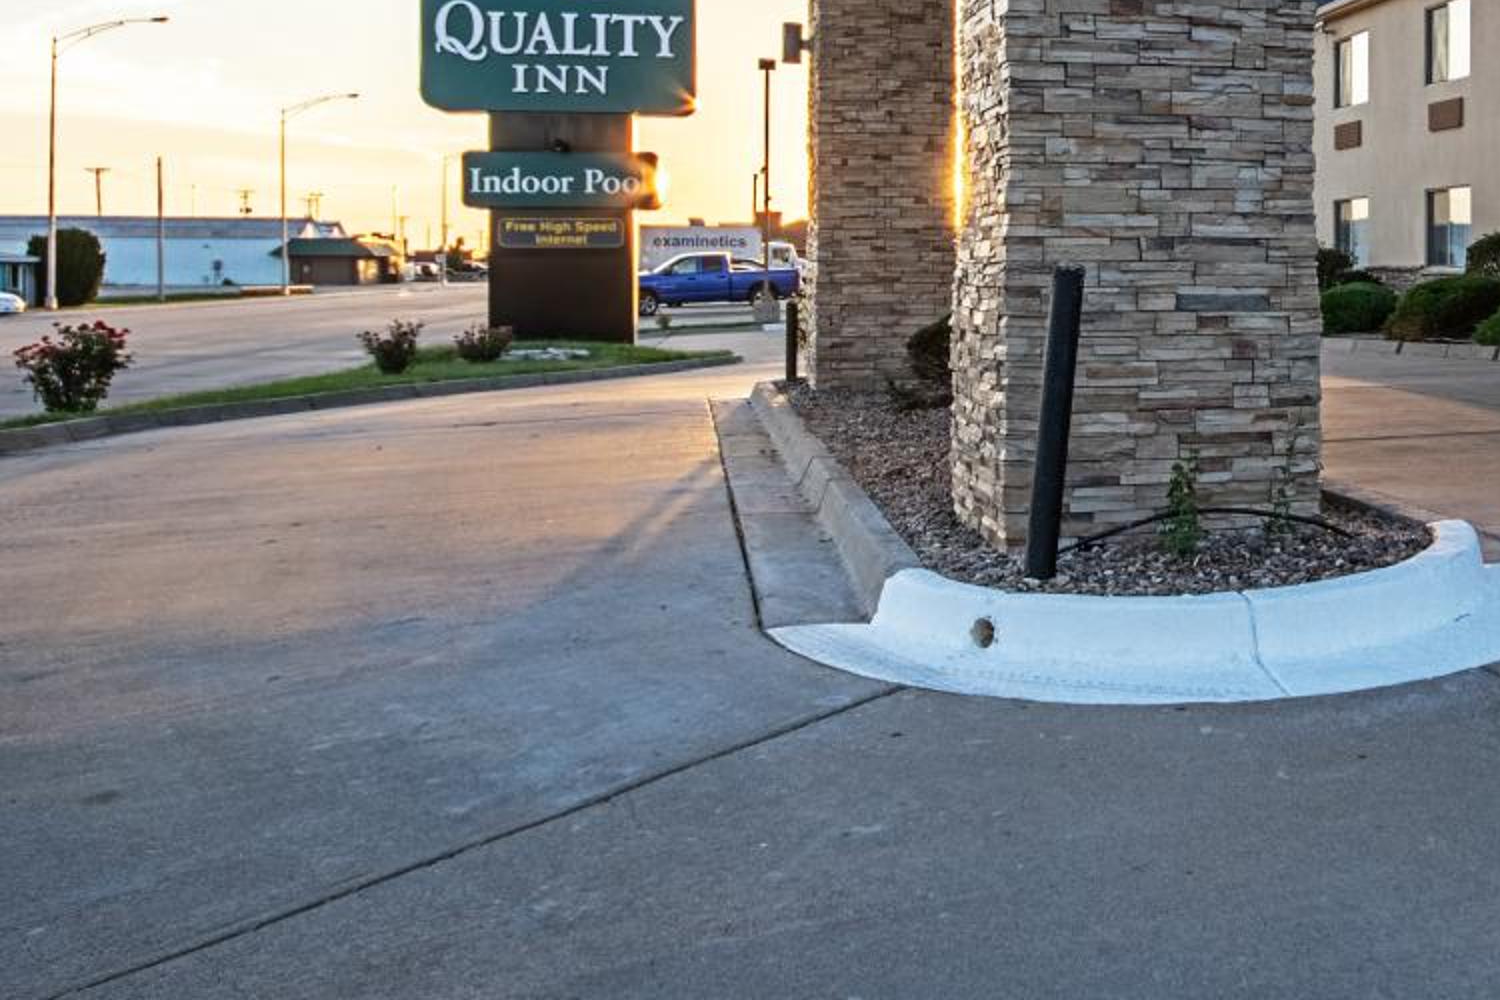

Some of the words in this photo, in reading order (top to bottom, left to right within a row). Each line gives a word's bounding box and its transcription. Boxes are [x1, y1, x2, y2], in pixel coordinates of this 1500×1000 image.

[434, 0, 684, 61] QUALITY
[511, 64, 609, 94] INN
[470, 166, 574, 194] Indoor
[584, 168, 642, 194] Poo
[505, 221, 536, 232] Free
[540, 221, 571, 234] High
[576, 221, 617, 233] Speed
[535, 233, 588, 245] Internet
[653, 233, 747, 249] examinetics
